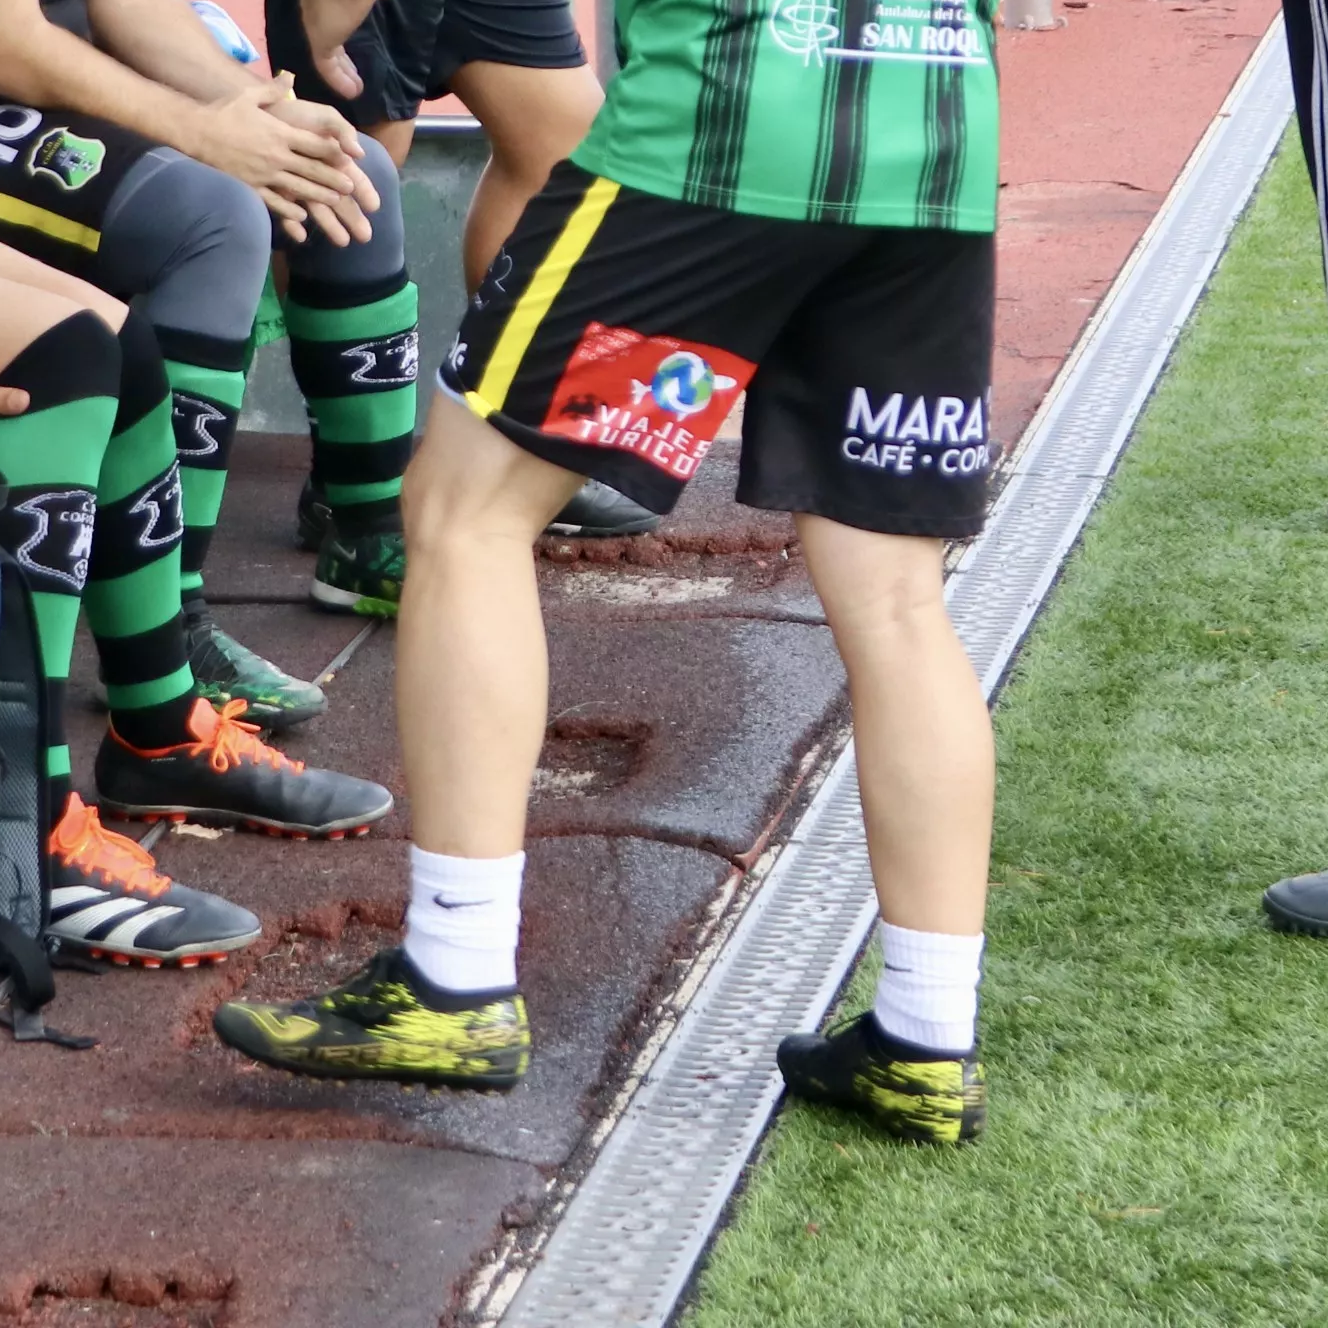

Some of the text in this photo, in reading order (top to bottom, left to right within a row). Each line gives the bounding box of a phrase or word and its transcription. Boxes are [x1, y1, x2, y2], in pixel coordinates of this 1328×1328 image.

[934, 7, 954, 21] del
[862, 21, 914, 50] SAN
[581, 419, 701, 476] TURICO
[600, 404, 713, 459] VIAJES
[842, 436, 917, 471] CAFÉ
